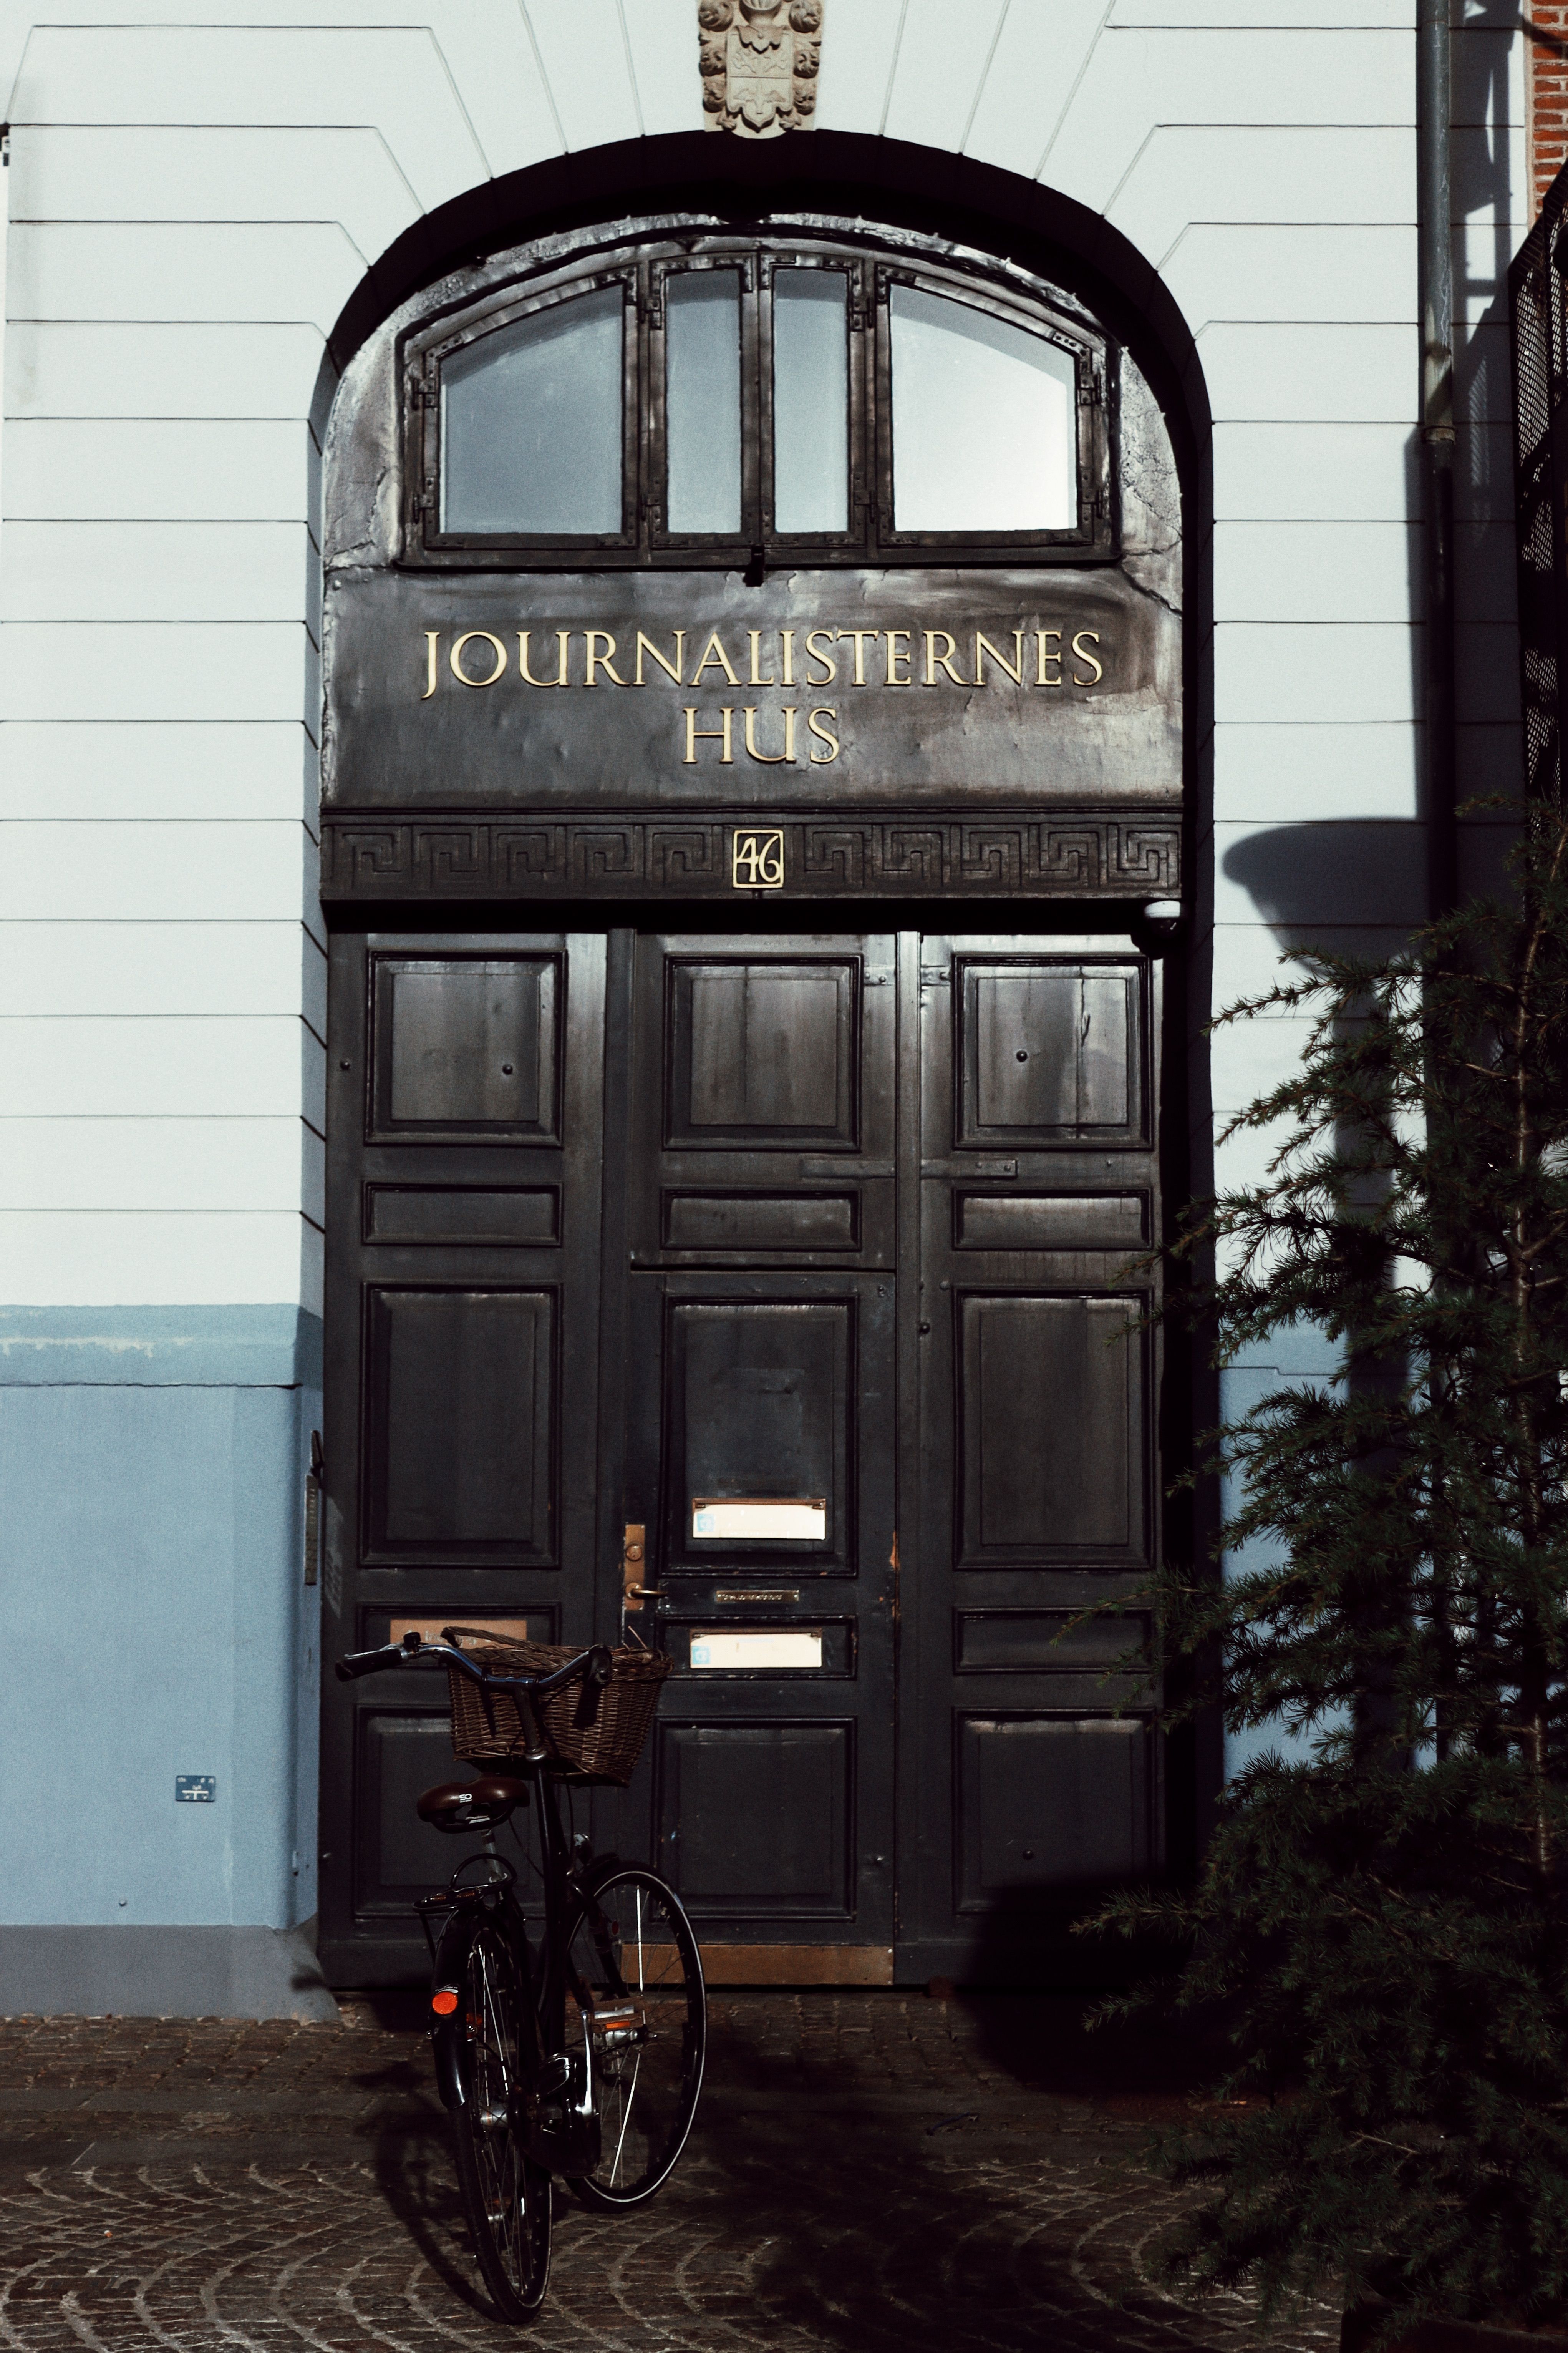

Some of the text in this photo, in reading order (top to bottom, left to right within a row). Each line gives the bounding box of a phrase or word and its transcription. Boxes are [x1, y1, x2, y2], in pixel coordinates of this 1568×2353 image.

[421, 629, 1103, 699] JOURNALISTERNES
[683, 707, 840, 763] HUS
[736, 835, 781, 883] 46
